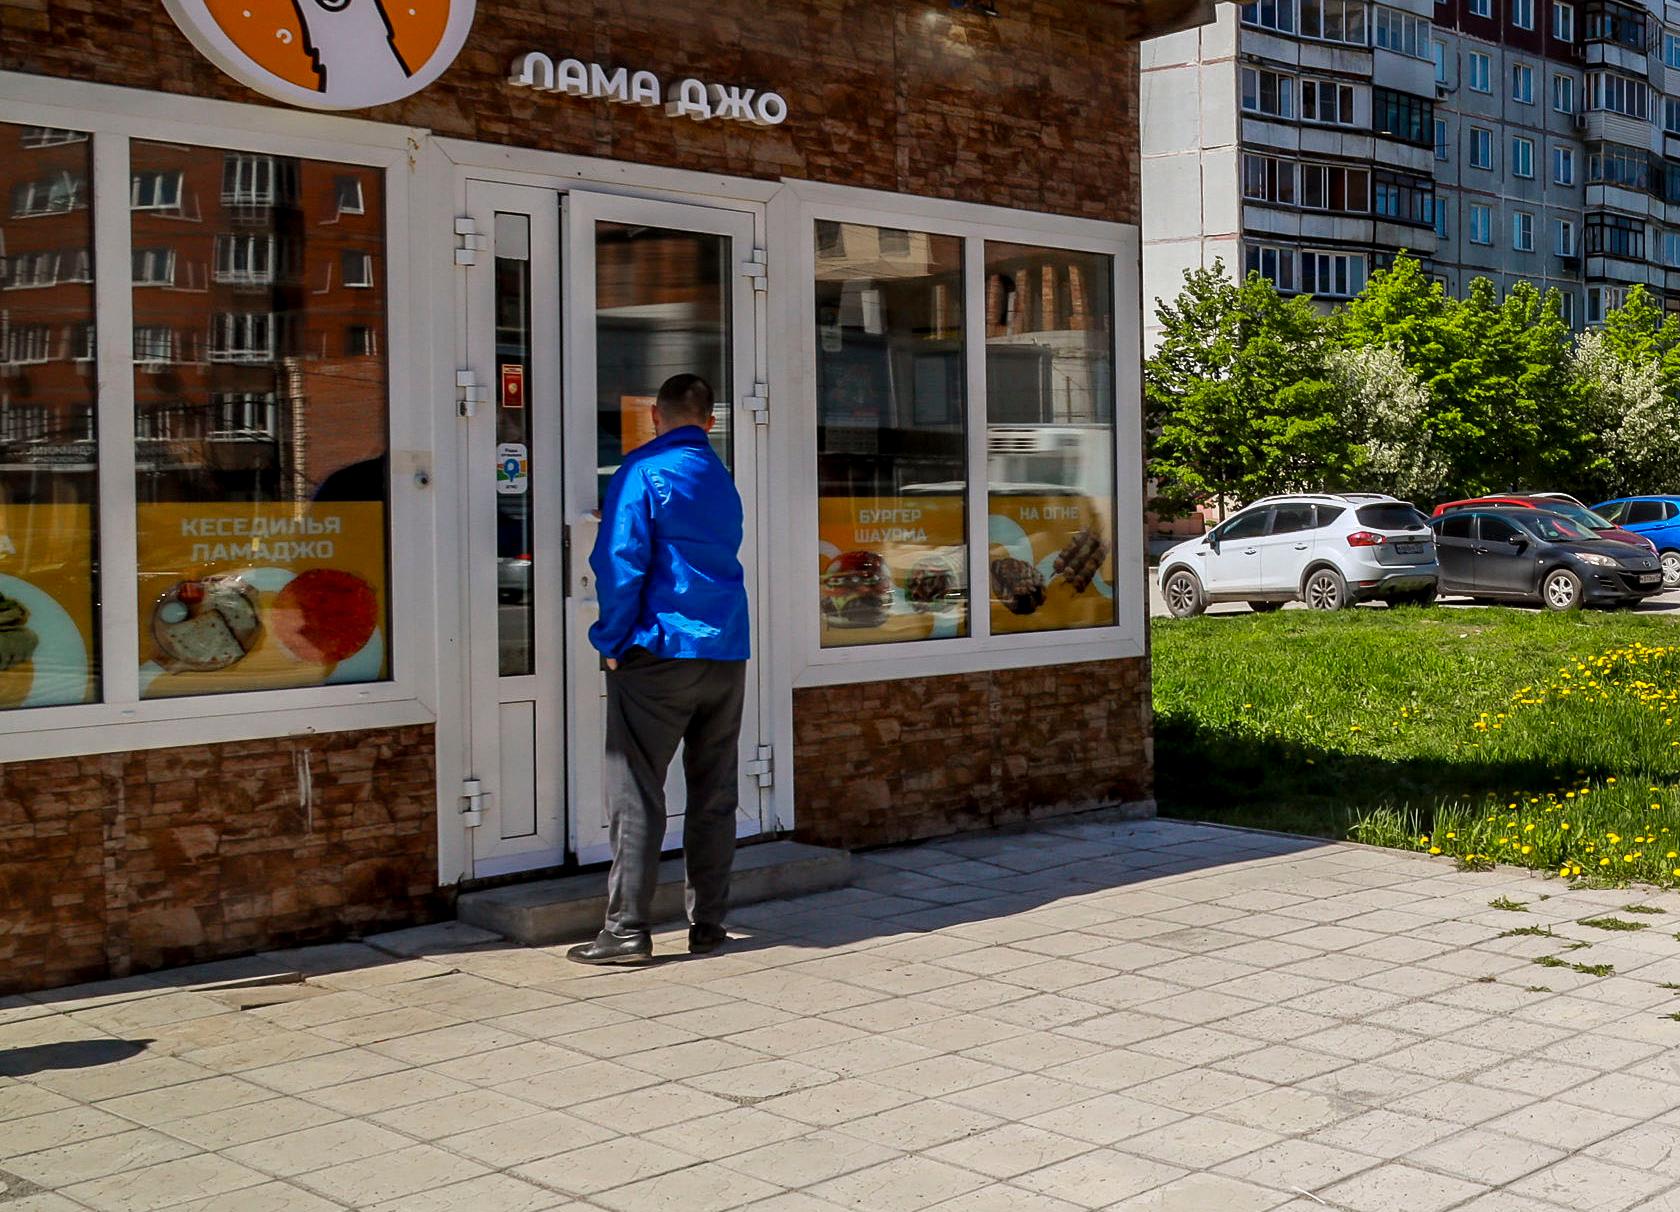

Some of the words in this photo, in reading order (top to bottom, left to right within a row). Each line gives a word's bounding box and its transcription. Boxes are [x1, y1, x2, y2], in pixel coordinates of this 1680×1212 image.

[509, 51, 662, 107] ЛАМА
[666, 78, 788, 126] ДЖО
[858, 508, 922, 524] БУРГЕР
[1019, 506, 1039, 521] НА
[1043, 505, 1080, 520] ОГНЕ
[180, 516, 342, 538] КЕСЕДИЛЬЯ
[190, 540, 334, 562] ЛАМАДЖО
